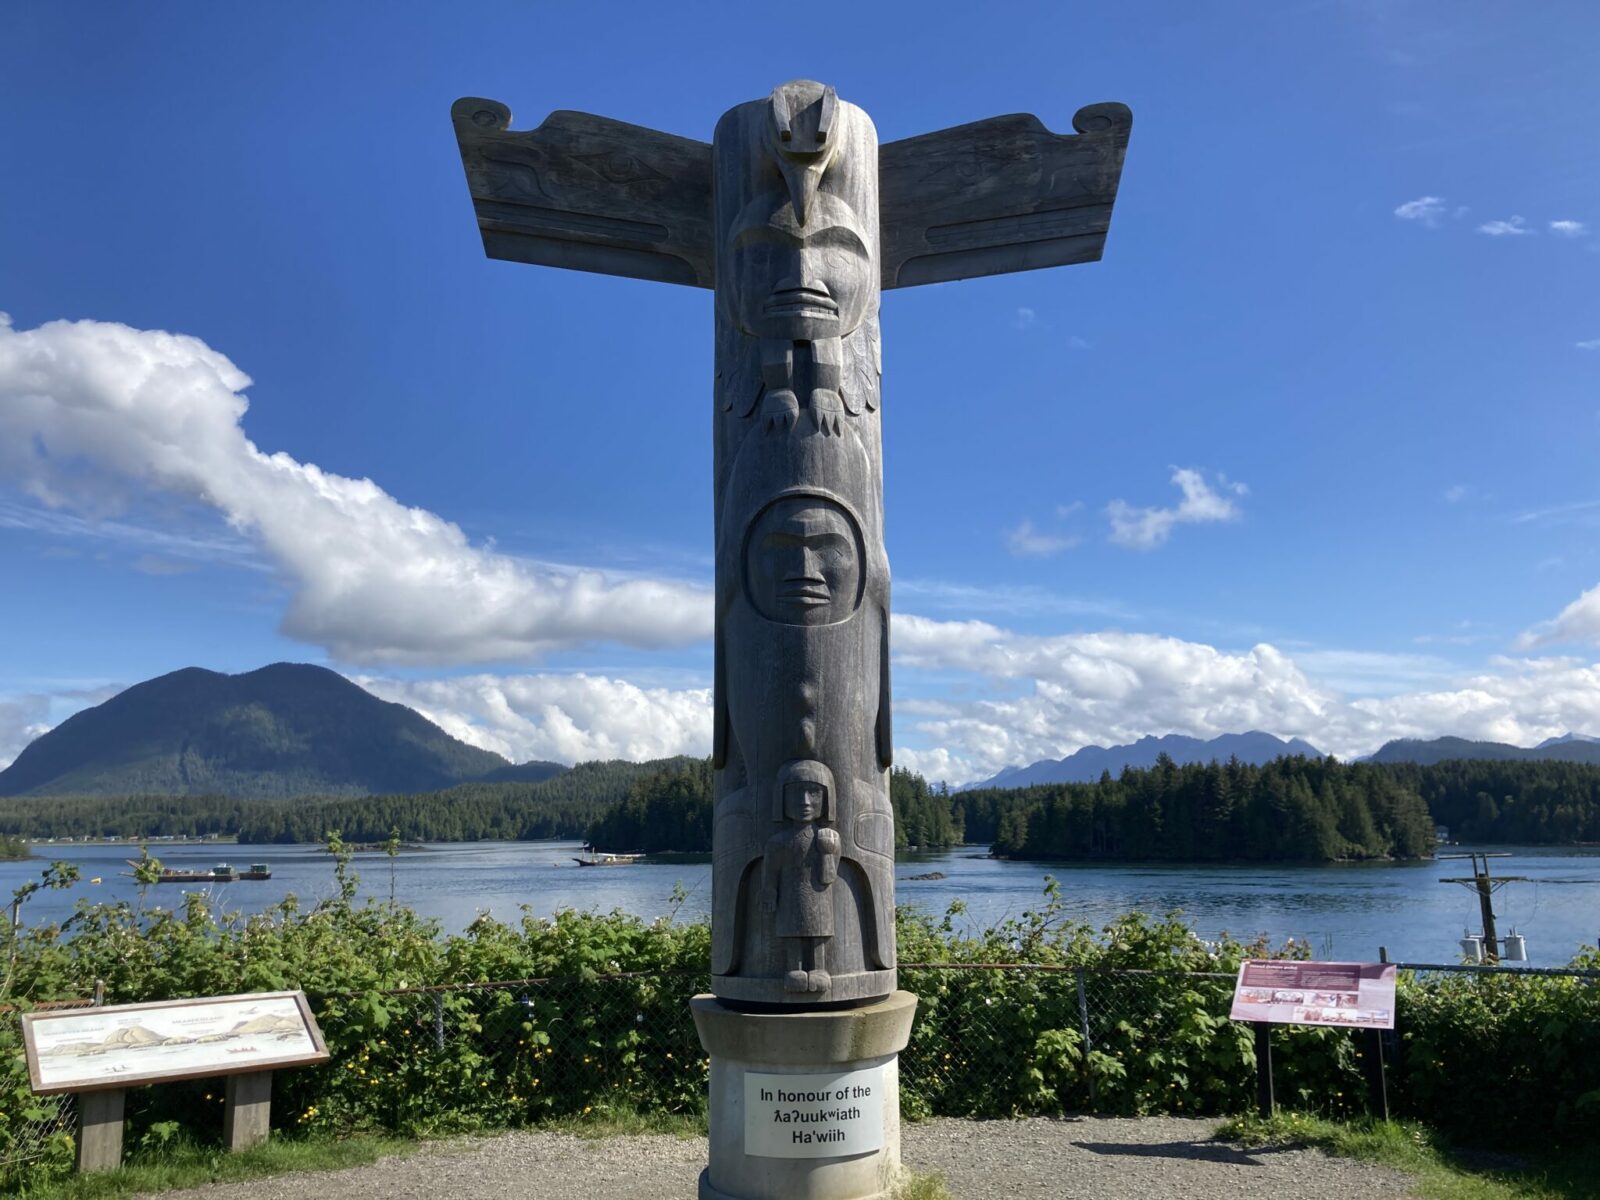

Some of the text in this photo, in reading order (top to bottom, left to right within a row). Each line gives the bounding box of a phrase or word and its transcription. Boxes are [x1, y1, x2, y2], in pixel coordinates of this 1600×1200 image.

[760, 1086, 871, 1102] In honour of the
[792, 1129, 845, 1144] Ha'wiih
